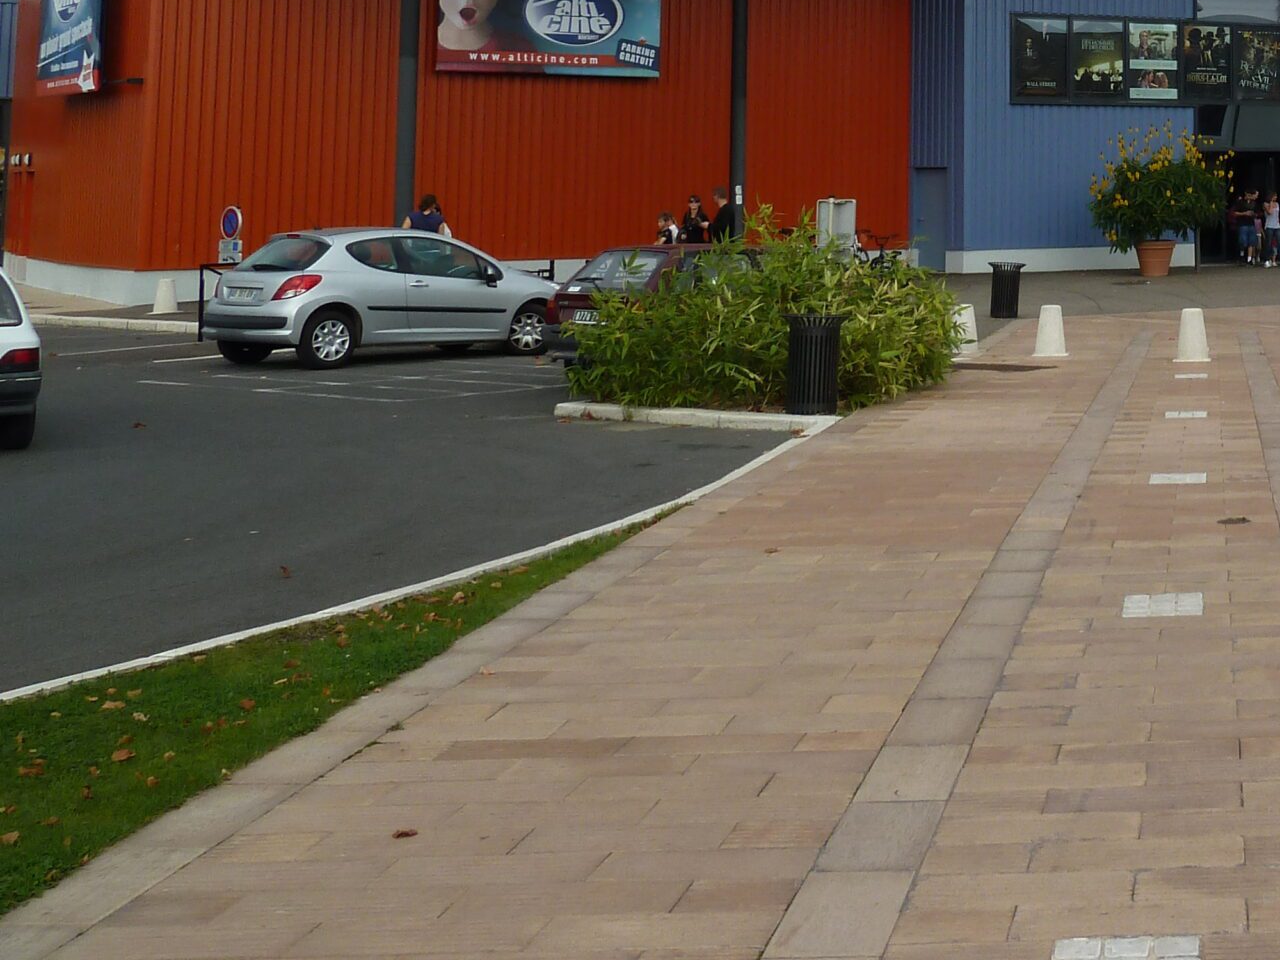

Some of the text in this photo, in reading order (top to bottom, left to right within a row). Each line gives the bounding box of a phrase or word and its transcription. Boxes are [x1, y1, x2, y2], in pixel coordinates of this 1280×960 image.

[620, 42, 656, 58] PARKING
[468, 52, 599, 65] www.alticine.com
[619, 51, 655, 67] GRATUIT
